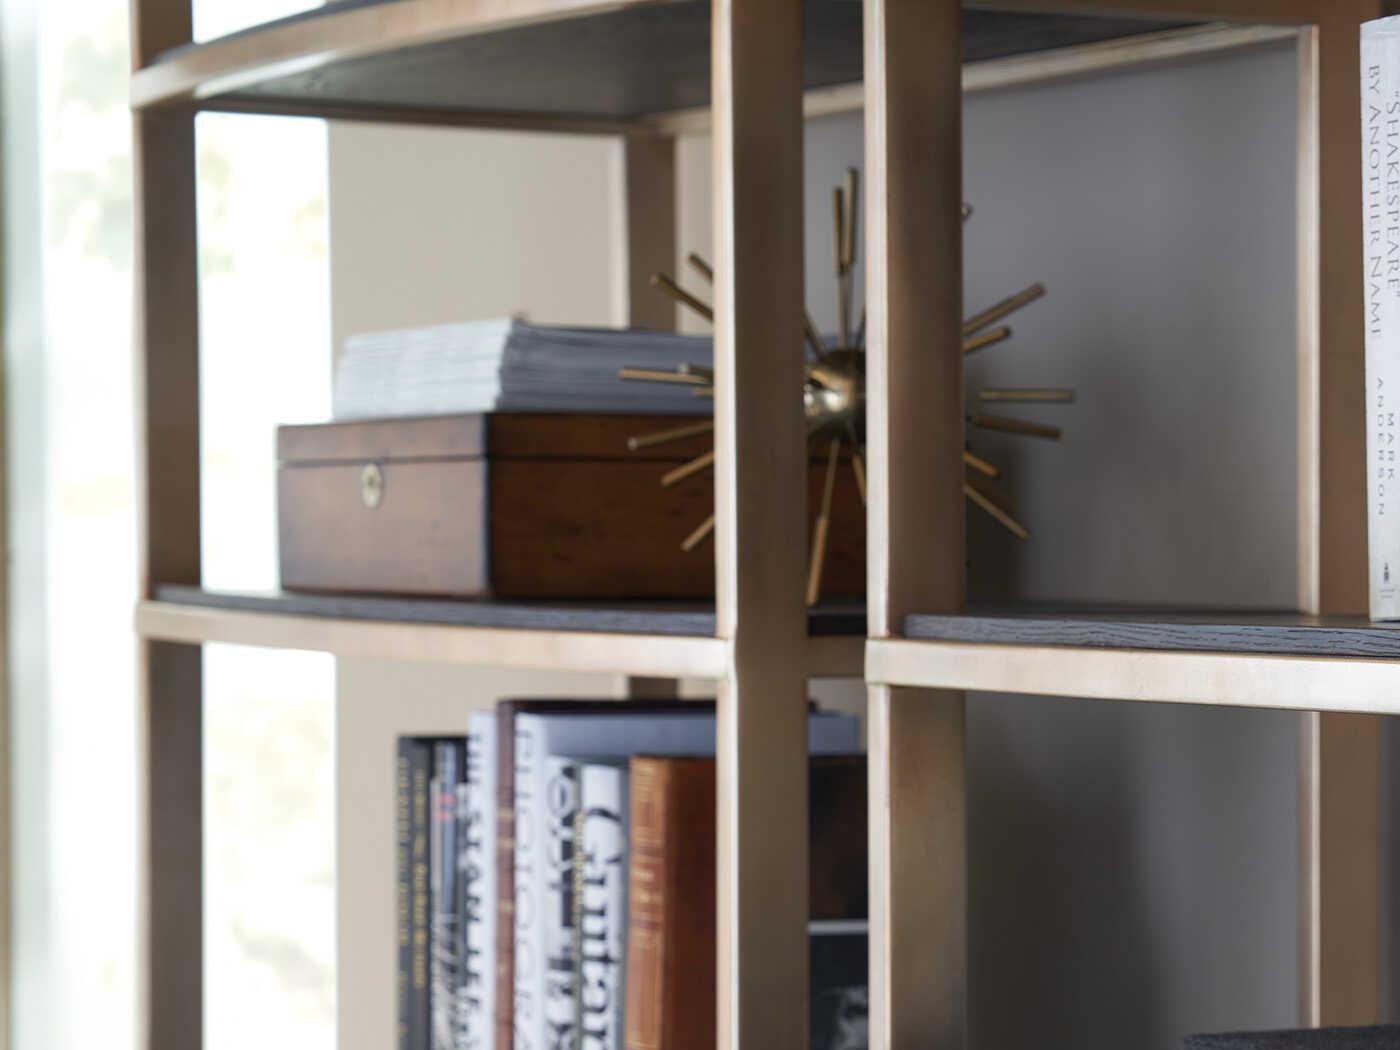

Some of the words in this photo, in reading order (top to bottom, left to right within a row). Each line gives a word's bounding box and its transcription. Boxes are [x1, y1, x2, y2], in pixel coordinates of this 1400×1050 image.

[1369, 64, 1380, 95] BY
[1369, 105, 1382, 246] ANOTHER
[1370, 256, 1382, 333] NAME
[1377, 376, 1385, 517] ANDERSON
[1387, 412, 1395, 480] MARK
